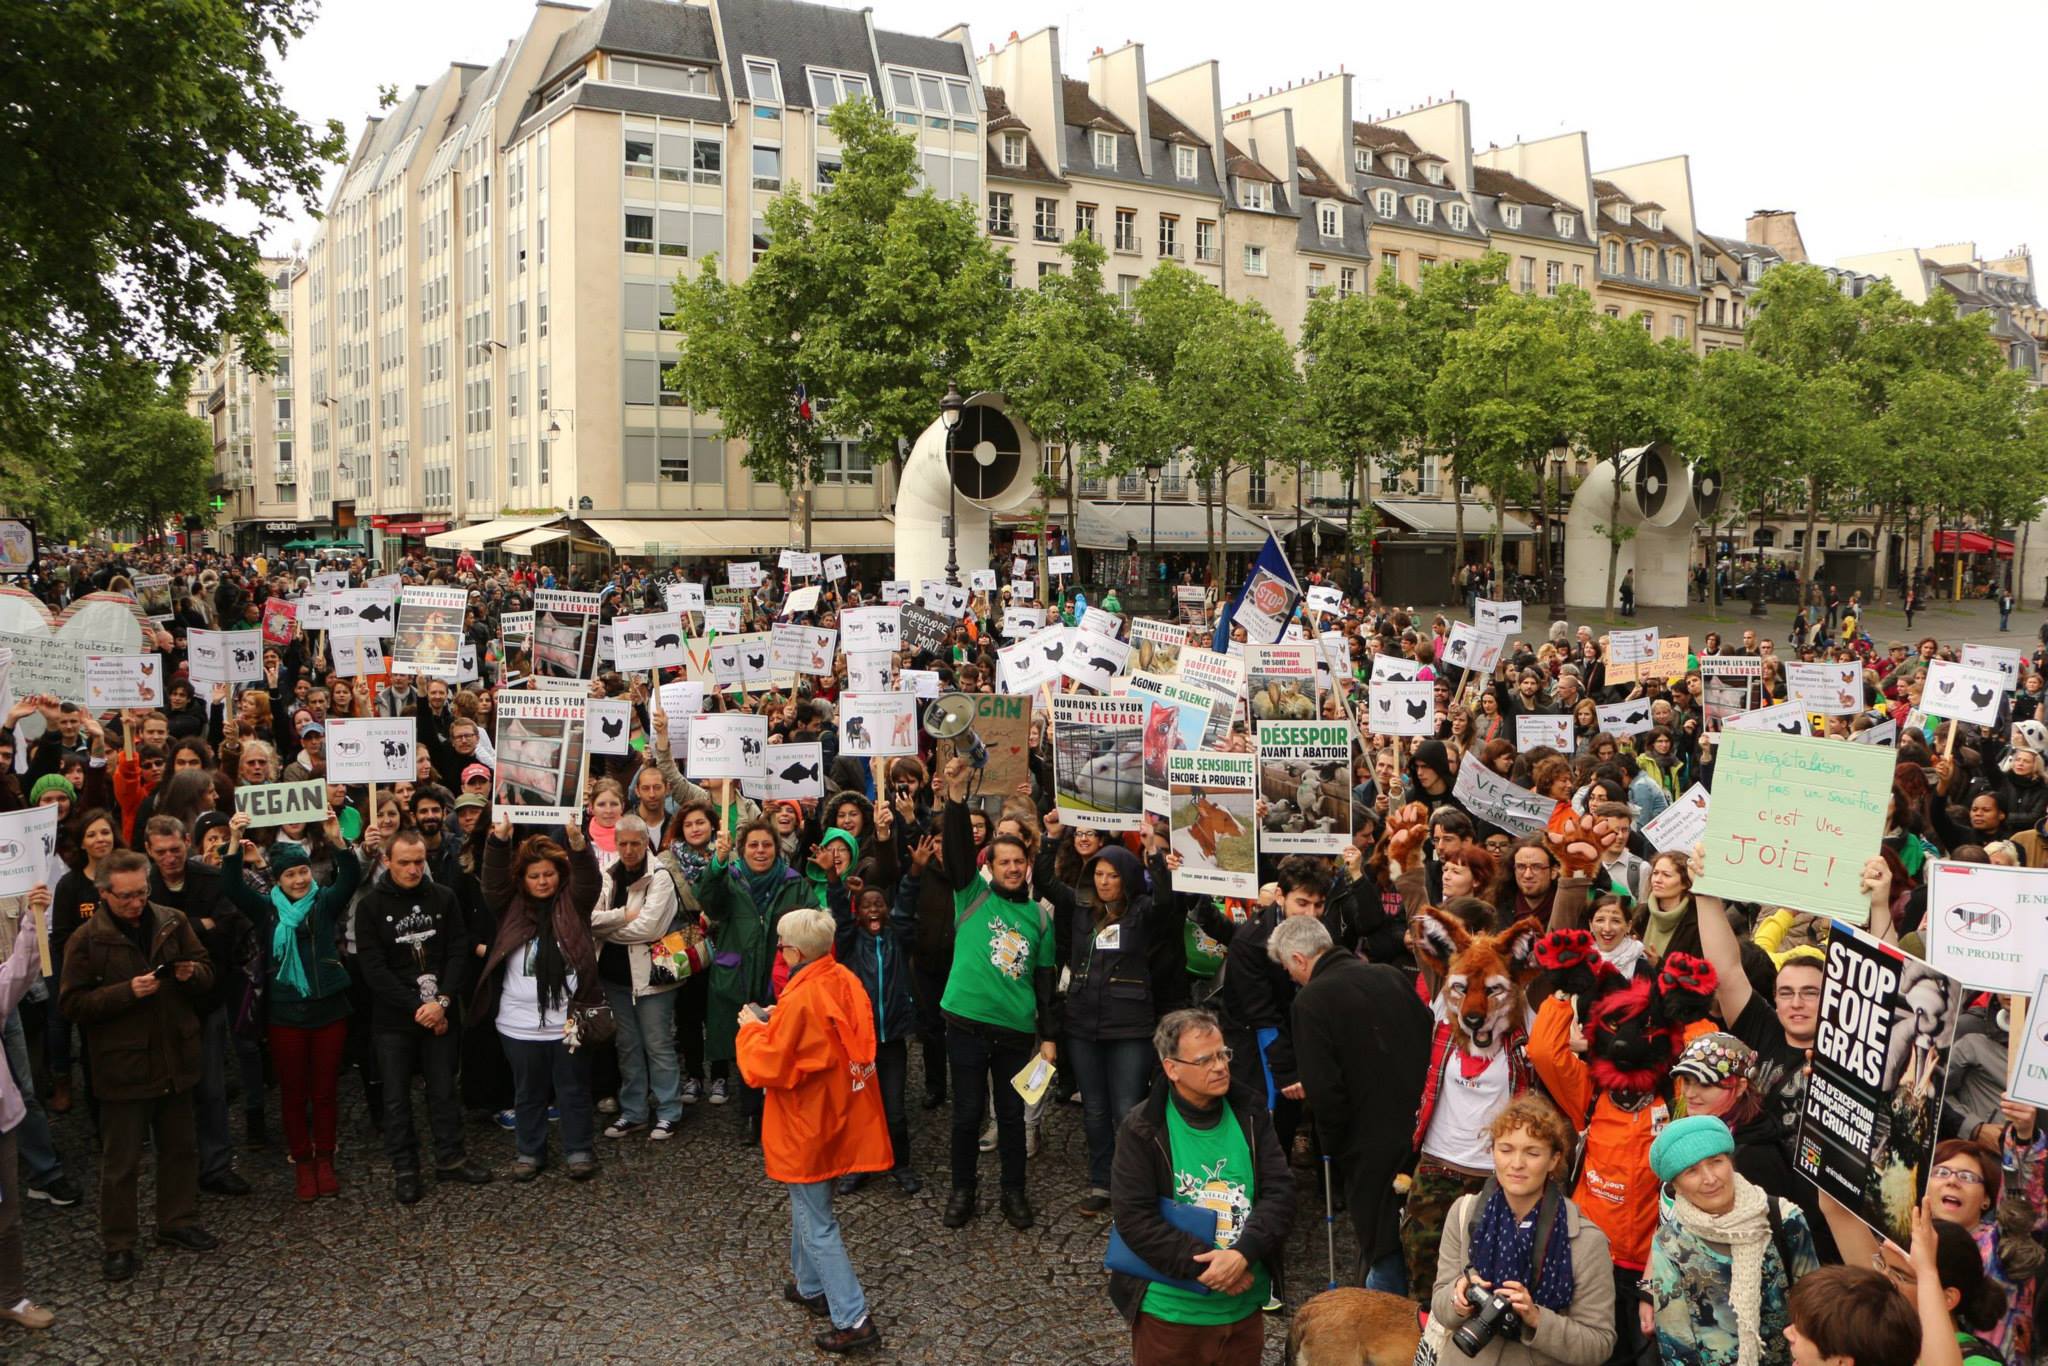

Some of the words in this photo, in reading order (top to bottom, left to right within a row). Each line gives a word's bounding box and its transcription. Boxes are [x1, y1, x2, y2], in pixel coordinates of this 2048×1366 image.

[403, 590, 434, 598] OUVRONS
[535, 593, 567, 601] OUVRONS
[569, 595, 581, 603] LES
[1259, 586, 1284, 608] STOP
[502, 614, 533, 624] OUVRONS
[1133, 620, 1159, 632] OUVRONS
[40, 639, 65, 651] pour
[74, 640, 107, 651] toutes
[110, 643, 125, 654] les
[914, 633, 942, 653] MORT
[1200, 654, 1208, 664] LE
[1210, 656, 1227, 667] LAIT
[1260, 650, 1271, 658] Les
[1272, 650, 1300, 658] animaux
[52, 661, 87, 674] attribu
[1184, 660, 1237, 679] SOUFFRANCE
[1252, 666, 1264, 674] des
[1264, 666, 1312, 674] marchandises
[498, 695, 541, 704] OUVRONS
[544, 696, 560, 705] LES
[563, 698, 585, 706] YEUX
[1130, 676, 1163, 694] AGONIE
[1164, 686, 1176, 698] EN
[1178, 690, 1211, 708] SILENCE
[498, 708, 516, 716] SUR
[522, 706, 585, 718] L'ÉLEVAGE
[978, 696, 1023, 720] GAN
[1054, 699, 1097, 710] OUVRONS
[1101, 701, 1116, 712] LES
[1120, 702, 1143, 712] YEUX
[1054, 712, 1072, 721] SUR
[1078, 711, 1144, 725] L'ÉLEVAGE
[1260, 722, 1348, 746] DÉSESPOIR
[1261, 747, 1292, 758] AVANT
[1170, 756, 1194, 770] LEUR
[1196, 757, 1253, 774] SENSIBILITÉ
[1755, 750, 1856, 778] végétalisme
[1170, 774, 1200, 784] ENCORE
[1209, 774, 1246, 786] PROUVER
[236, 786, 323, 816] VEGAN
[1476, 774, 1541, 816] VEGAN
[1725, 770, 1763, 786] n'est
[1768, 784, 1790, 800] pas
[1803, 788, 1822, 798] un
[1828, 790, 1881, 814] sacrifice
[1758, 808, 1804, 826] c'est
[1816, 816, 1844, 836] Une
[1823, 856, 1836, 886] !
[2016, 894, 2031, 904] JE
[2033, 895, 2048, 905] NE
[1946, 945, 1964, 957] UN
[1967, 948, 2024, 964] PRODUIT
[1826, 942, 1897, 1005] STOP
[1820, 977, 1890, 1054] FOIE
[1817, 1020, 1884, 1087] GRAS
[2027, 1064, 2048, 1080] UN
[1454, 1078, 1482, 1089] NATIVE
[1812, 1073, 1827, 1090] PAS
[1827, 1081, 1875, 1124] D'EXCEPTION
[1810, 1084, 1850, 1122] FRANÇAISE
[1850, 1113, 1873, 1136] POUR
[1807, 1098, 1820, 1120] LA
[1822, 1108, 1871, 1154] CRUAUTÉ
[1800, 1157, 1818, 1176] L214
